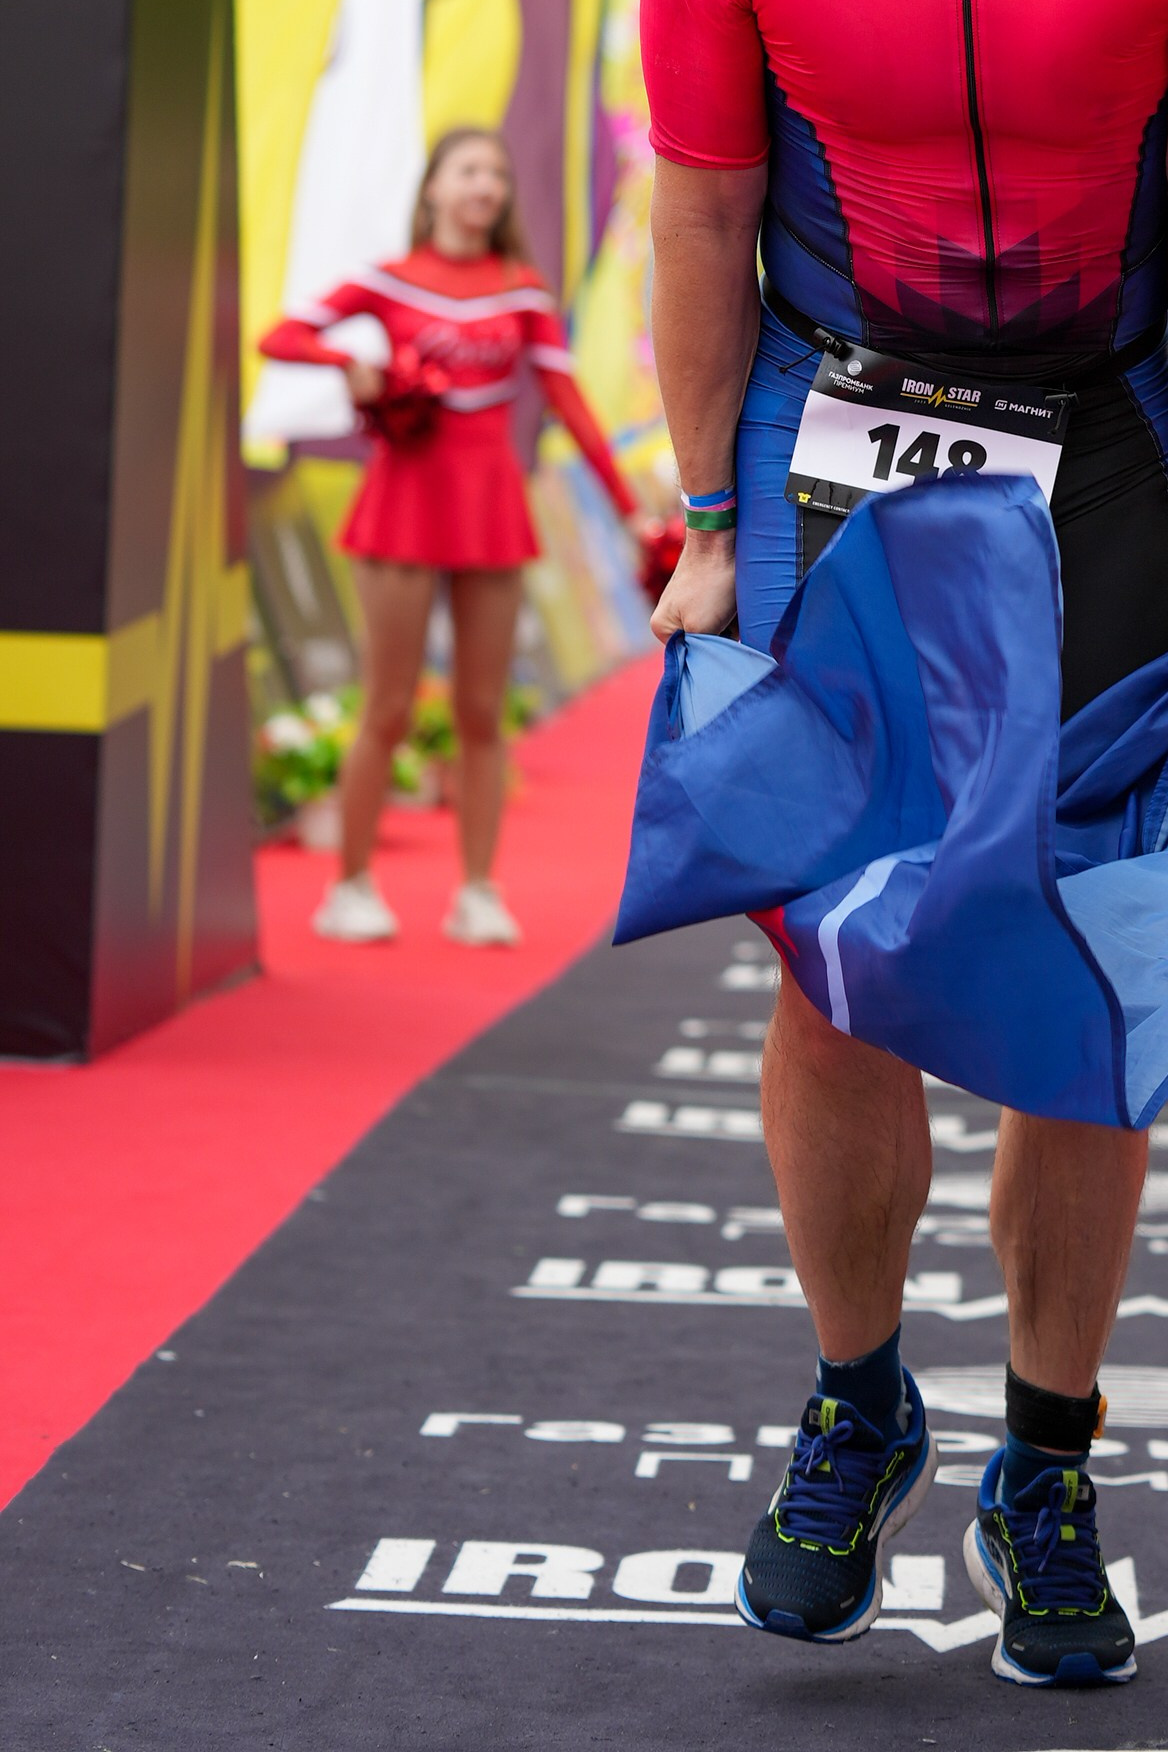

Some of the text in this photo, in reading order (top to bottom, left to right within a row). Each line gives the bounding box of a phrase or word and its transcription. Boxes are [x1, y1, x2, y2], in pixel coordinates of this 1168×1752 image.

[828, 370, 874, 392] ГАЗПРОМБАНК
[833, 379, 866, 395] ПРЕМИУМ
[902, 377, 982, 403] IRON STAR
[1009, 402, 1054, 420] МАГНИТ
[867, 422, 988, 486] 148
